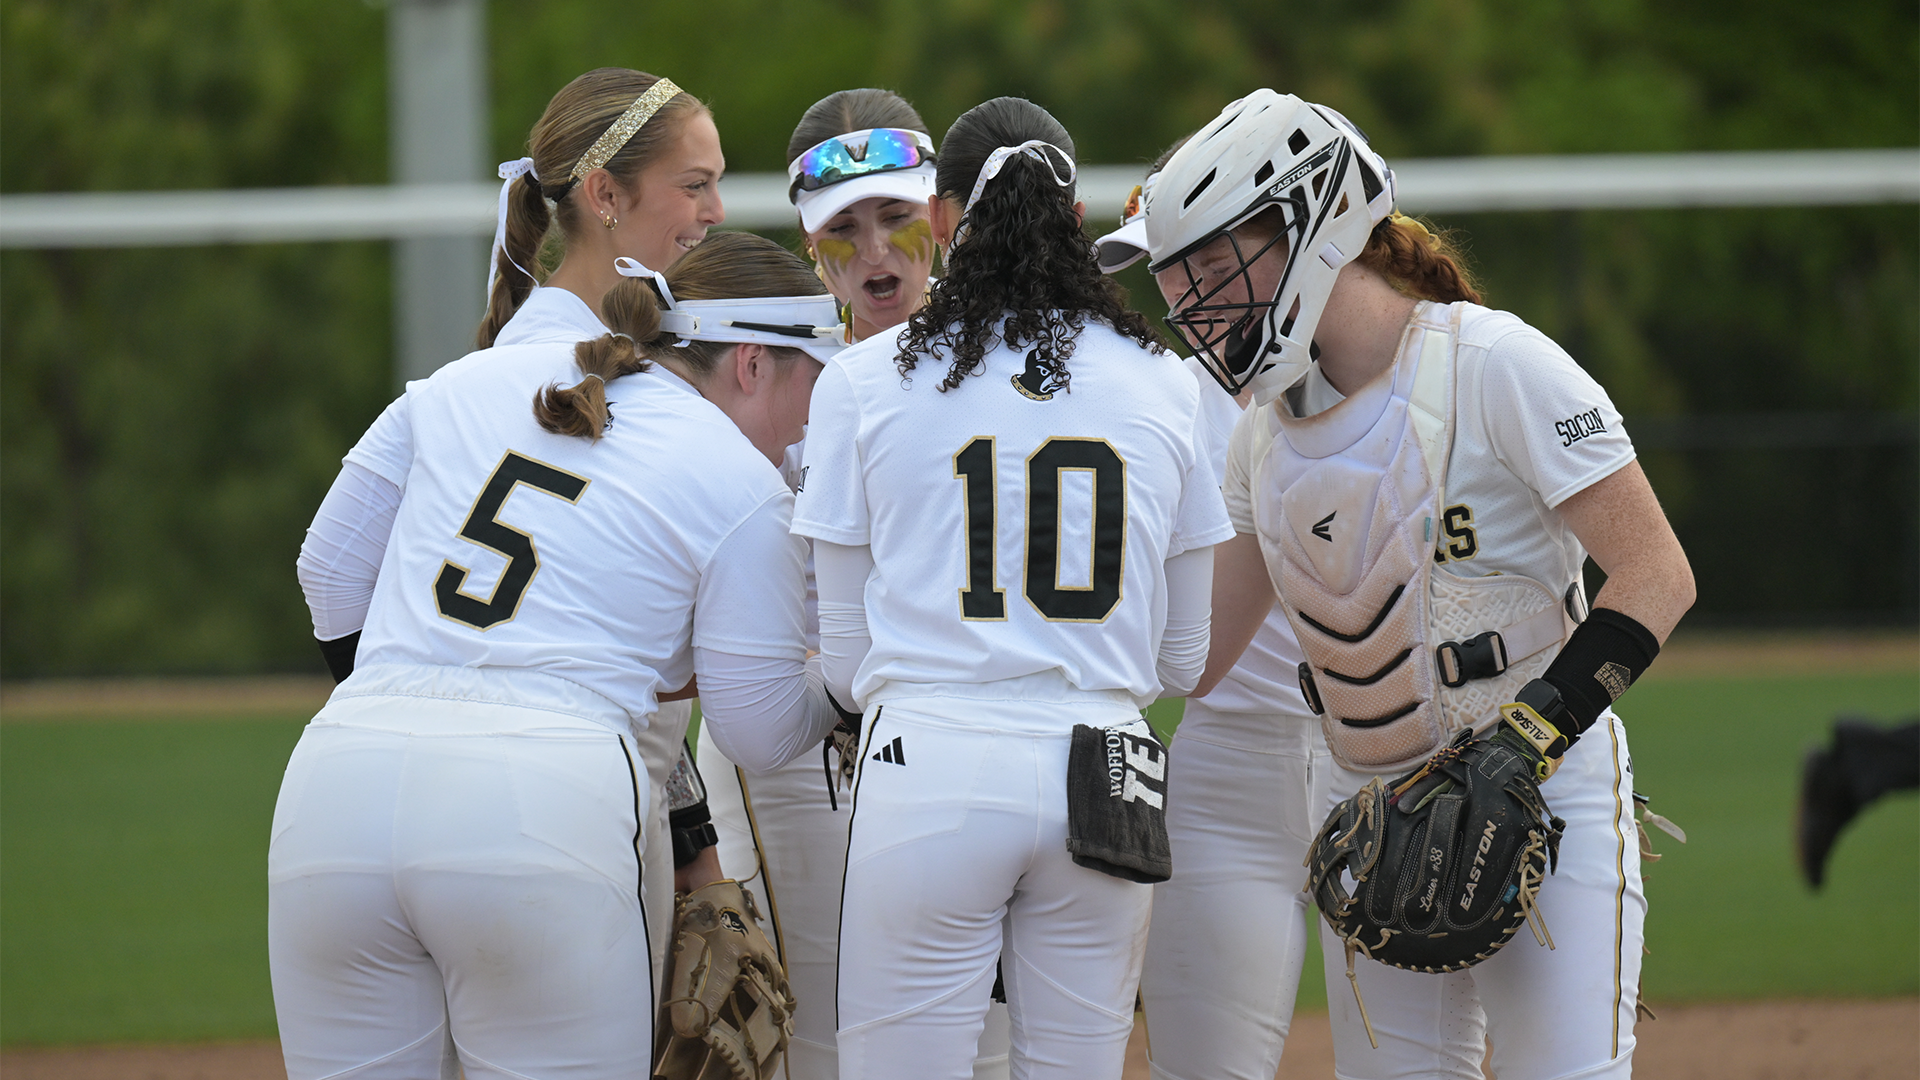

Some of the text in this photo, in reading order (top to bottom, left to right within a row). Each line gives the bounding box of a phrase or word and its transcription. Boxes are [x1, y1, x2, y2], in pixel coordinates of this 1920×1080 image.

[1269, 163, 1312, 196] EASTON
[1554, 407, 1607, 448] SOCON
[431, 448, 592, 633] 5
[952, 435, 1128, 624] 10
[1419, 847, 1443, 913] Lucier #33
[1459, 819, 1497, 912] EASTON
